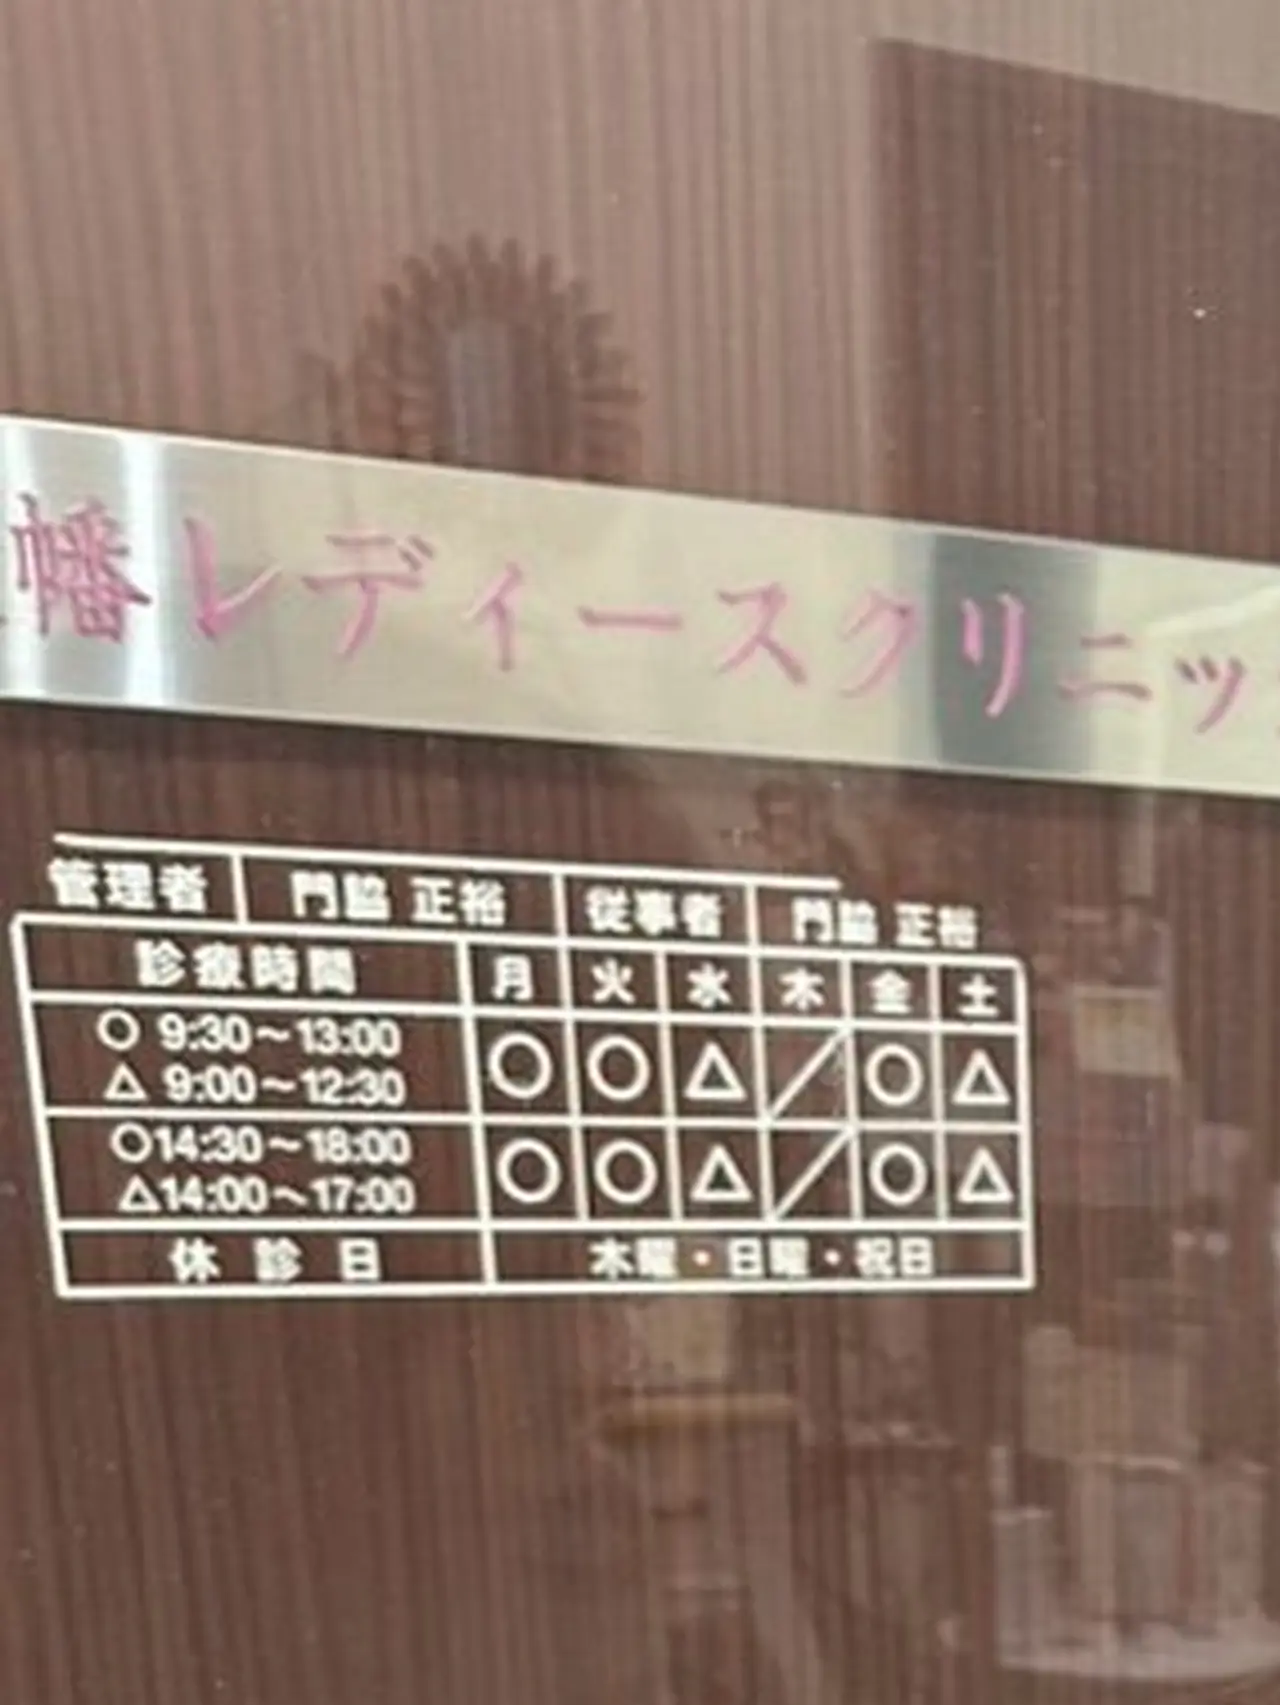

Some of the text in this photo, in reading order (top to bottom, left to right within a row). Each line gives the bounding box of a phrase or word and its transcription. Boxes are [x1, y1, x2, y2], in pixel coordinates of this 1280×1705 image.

[48, 858, 207, 913] 管理者
[135, 939, 998, 1017] 診療時間 月 火 水 木 金 土
